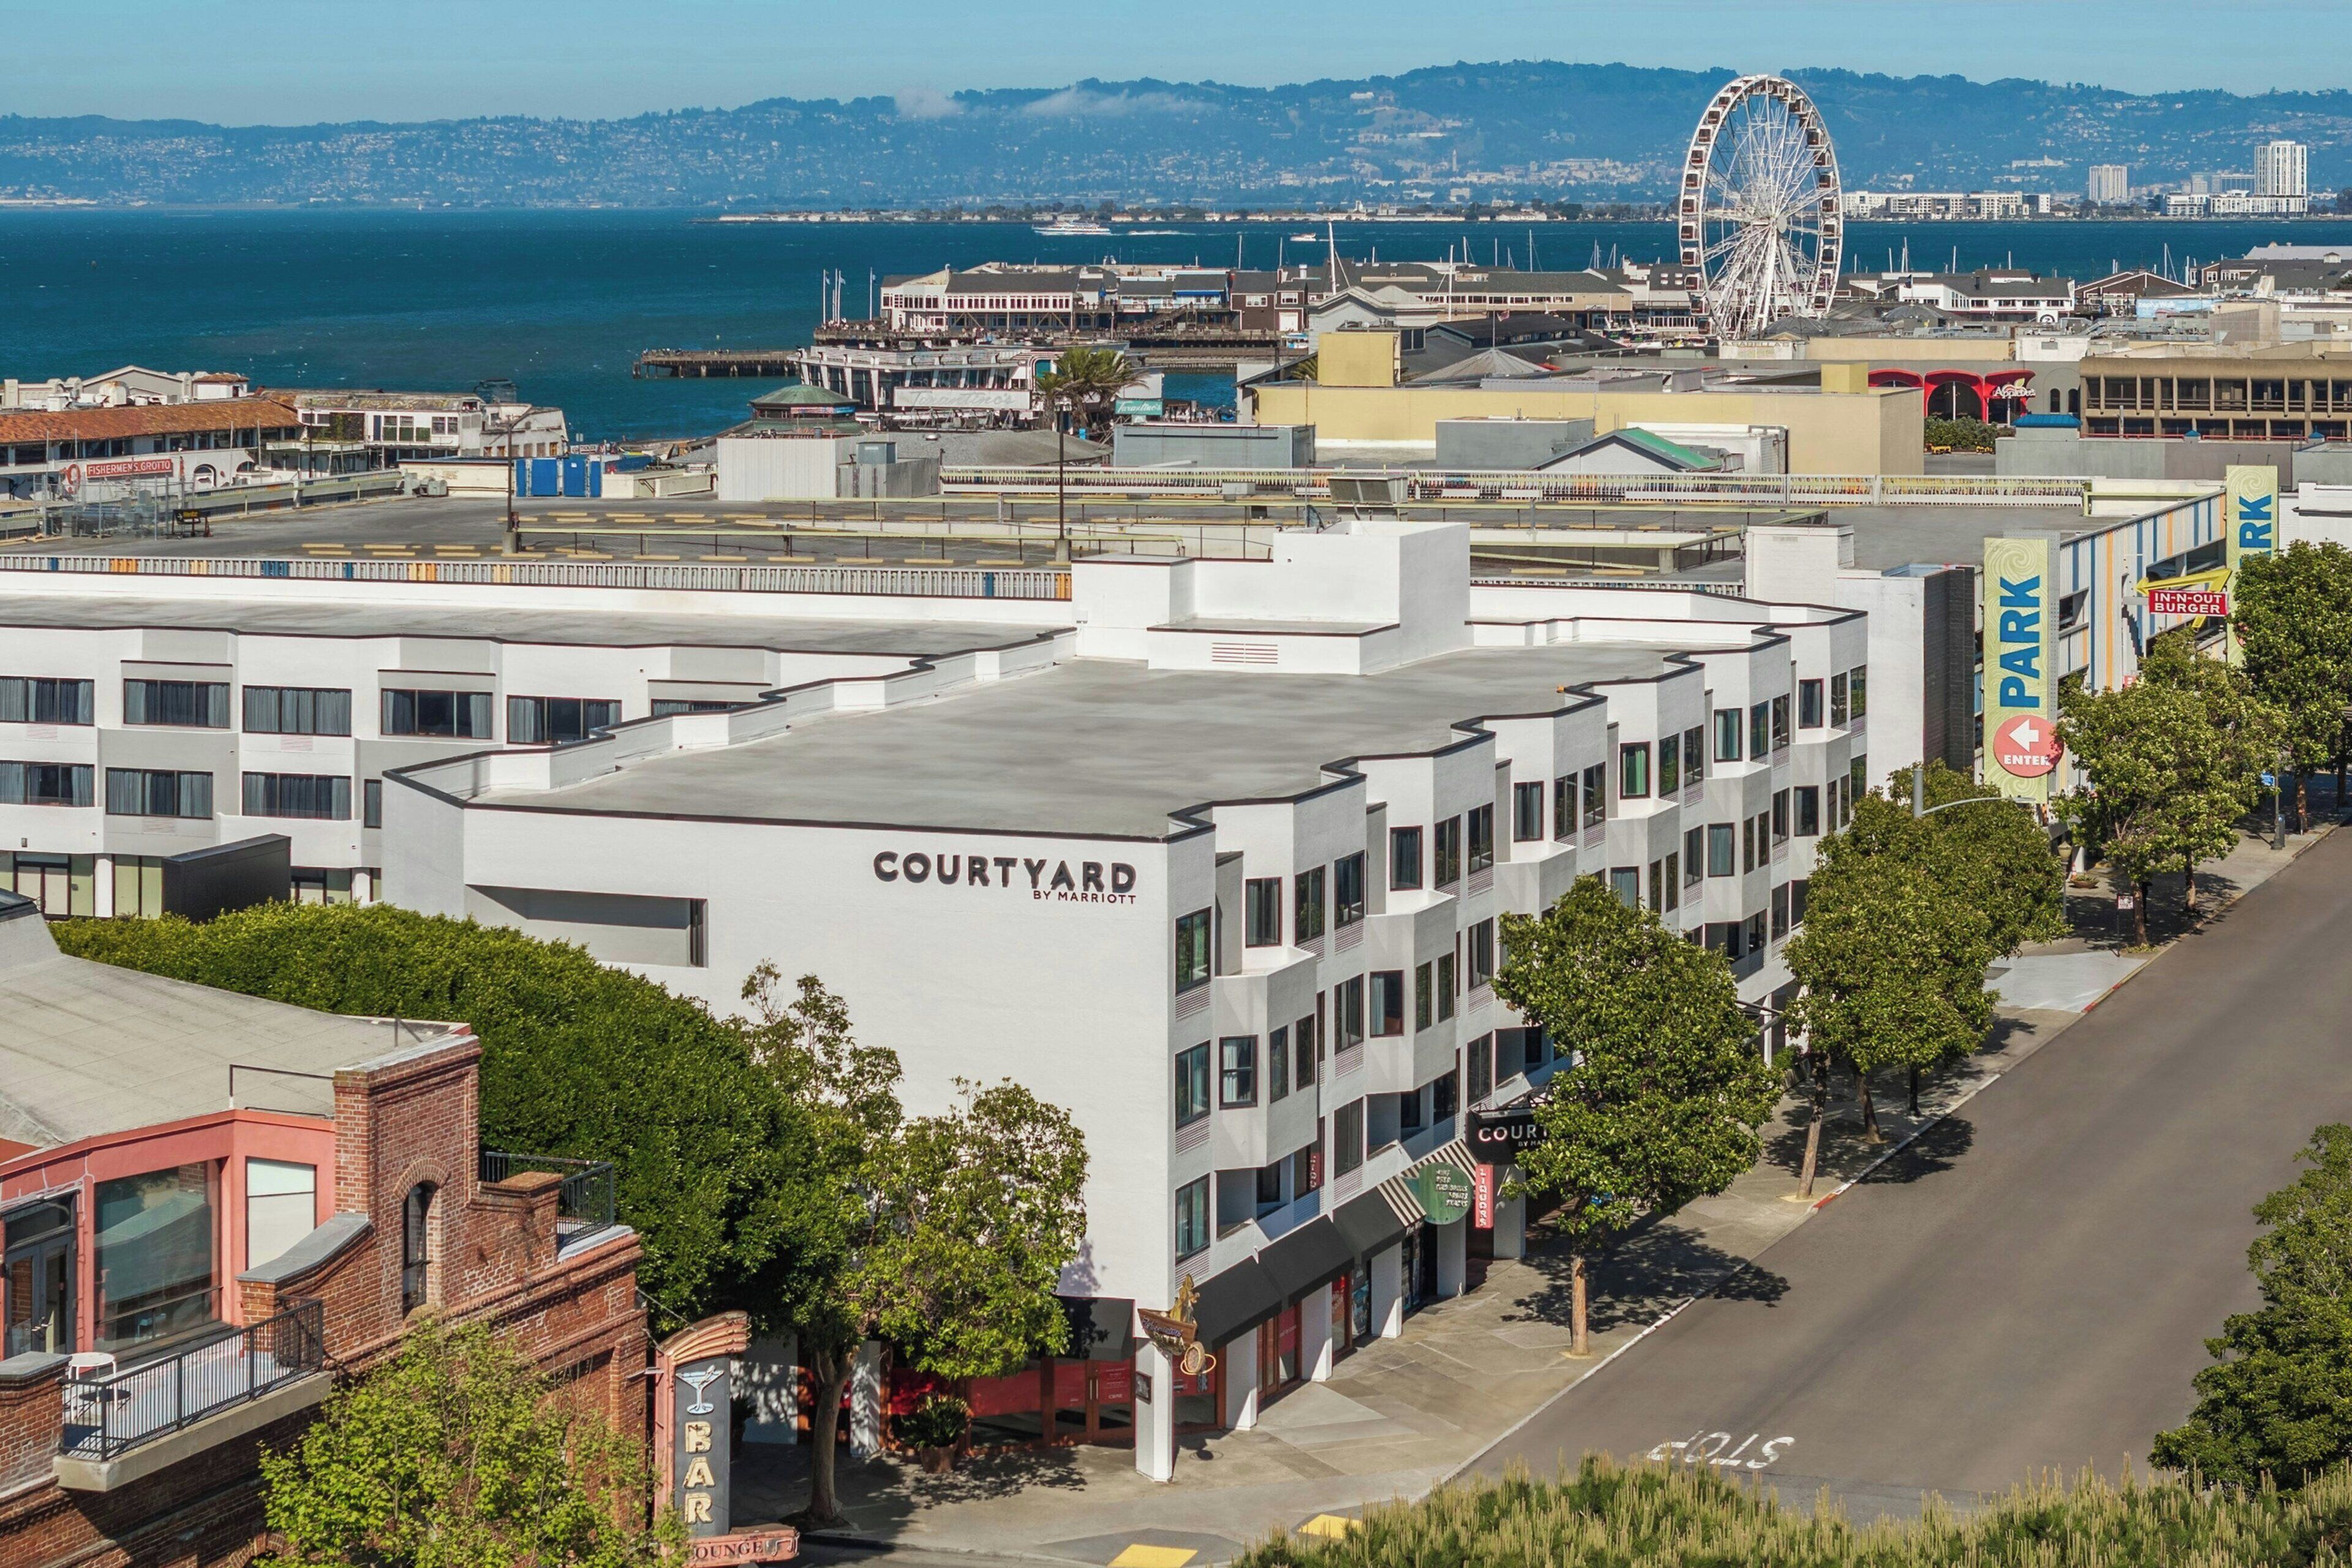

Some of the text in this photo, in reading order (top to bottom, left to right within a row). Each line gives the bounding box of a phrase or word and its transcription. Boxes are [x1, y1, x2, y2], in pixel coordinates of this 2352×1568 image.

[1117, 401, 1161, 414] Tarantino's
[140, 460, 171, 470] GROTTO
[2239, 494, 2271, 567] RK
[2154, 592, 2222, 604] IN-N-OUT
[2154, 603, 2220, 614] BURGER
[2000, 575, 2040, 708] PARK
[2004, 755, 2051, 766] ENTER
[873, 851, 1137, 893] COURTYARD
[1033, 891, 1137, 905] BY MARRIOTT
[1478, 1125, 1548, 1142] COURT
[1479, 1169, 1488, 1226] LIQUORS
[1646, 1430, 1795, 1469] STOP
[683, 1420, 716, 1525] BAR
[692, 1541, 764, 1559] OUNGE
